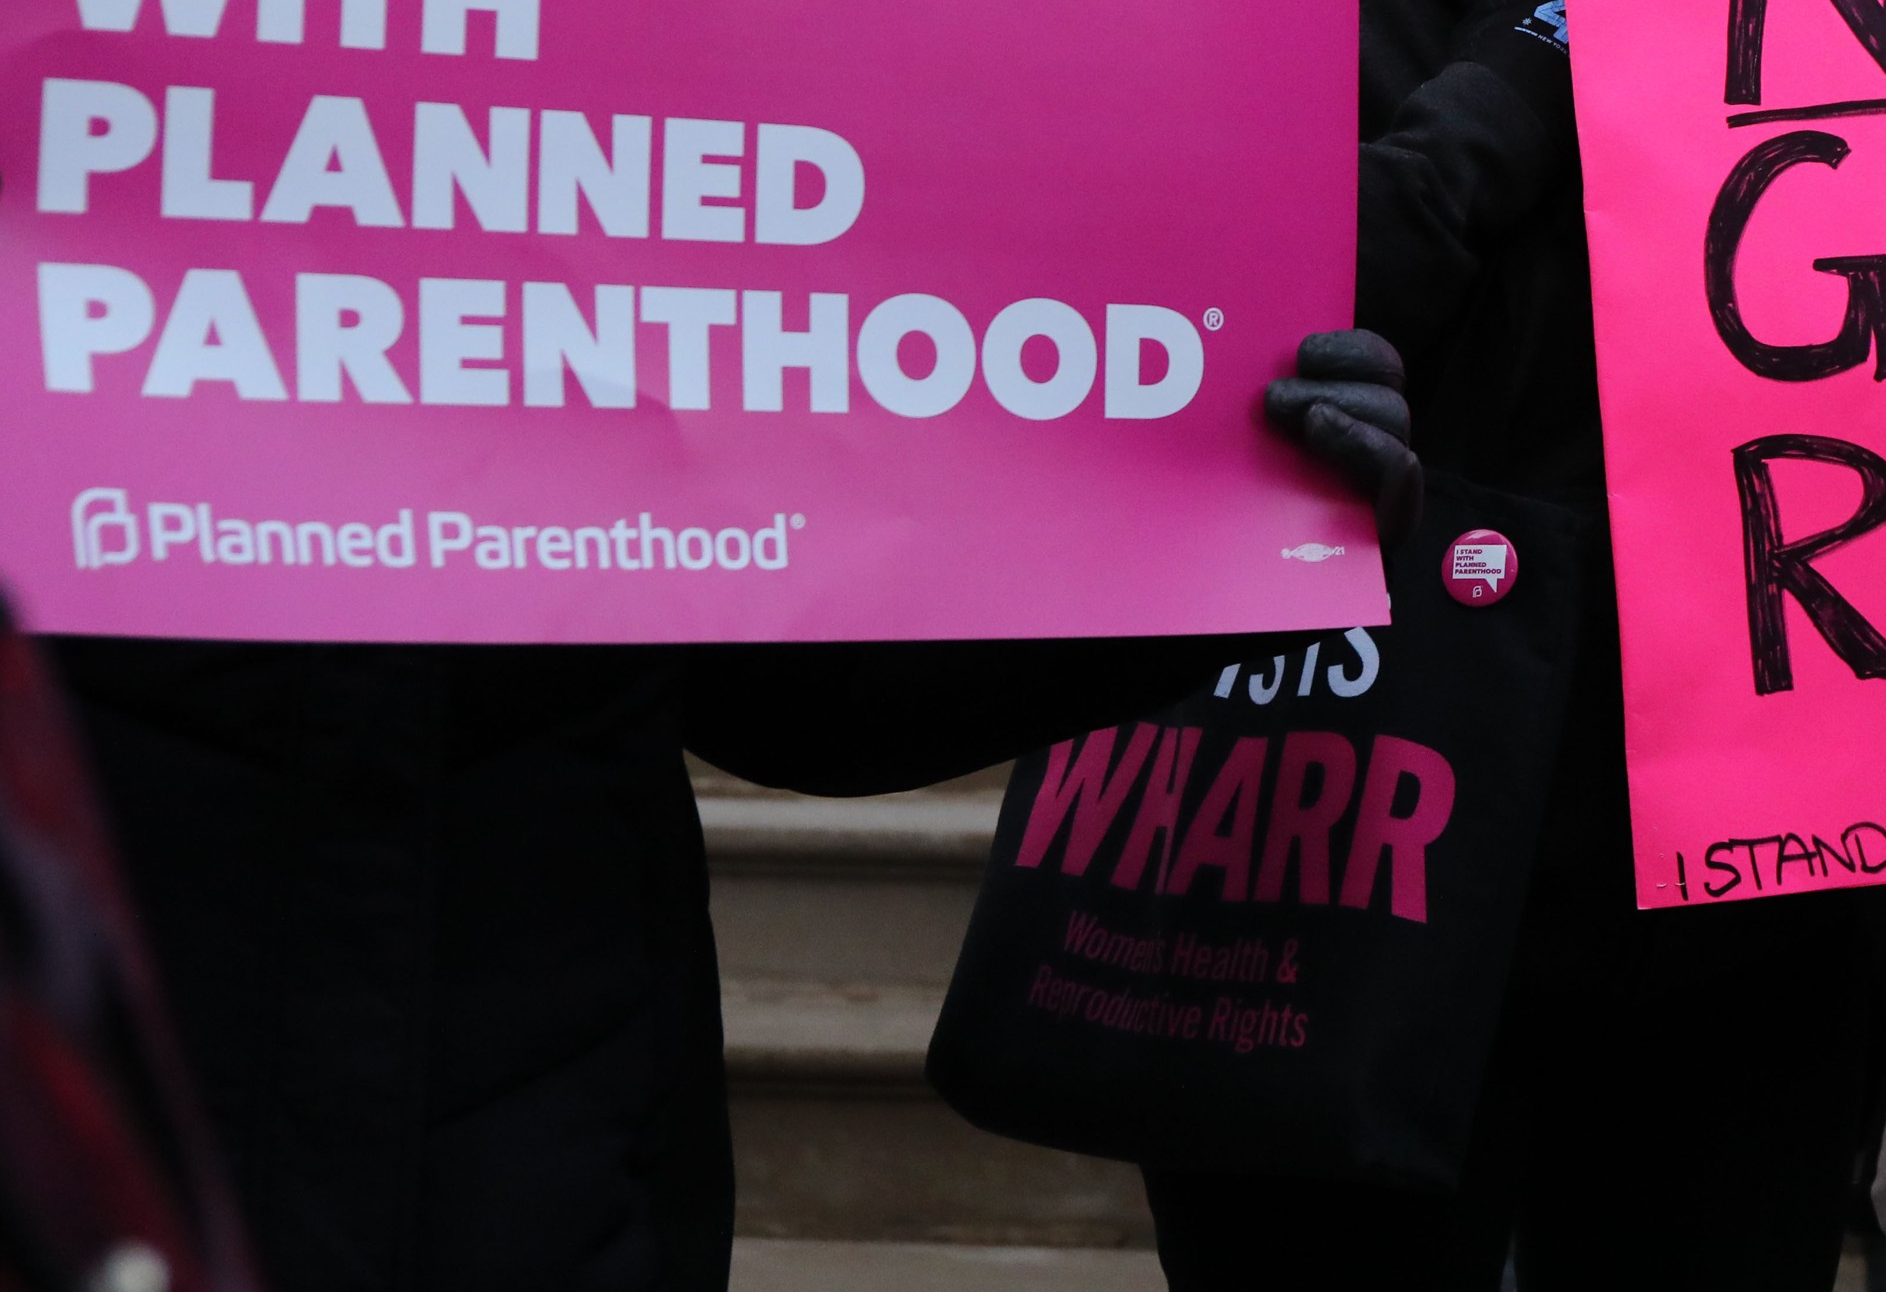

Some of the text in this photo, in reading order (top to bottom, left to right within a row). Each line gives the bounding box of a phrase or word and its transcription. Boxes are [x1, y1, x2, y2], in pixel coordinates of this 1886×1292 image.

[36, 77, 866, 247] PLANNED
[148, 502, 414, 567] Planned
[1014, 721, 1456, 924] WHARR
[1170, 932, 1270, 982] Health
[1277, 937, 1300, 984] &
[1028, 964, 1310, 1053] Reproductive Rights
